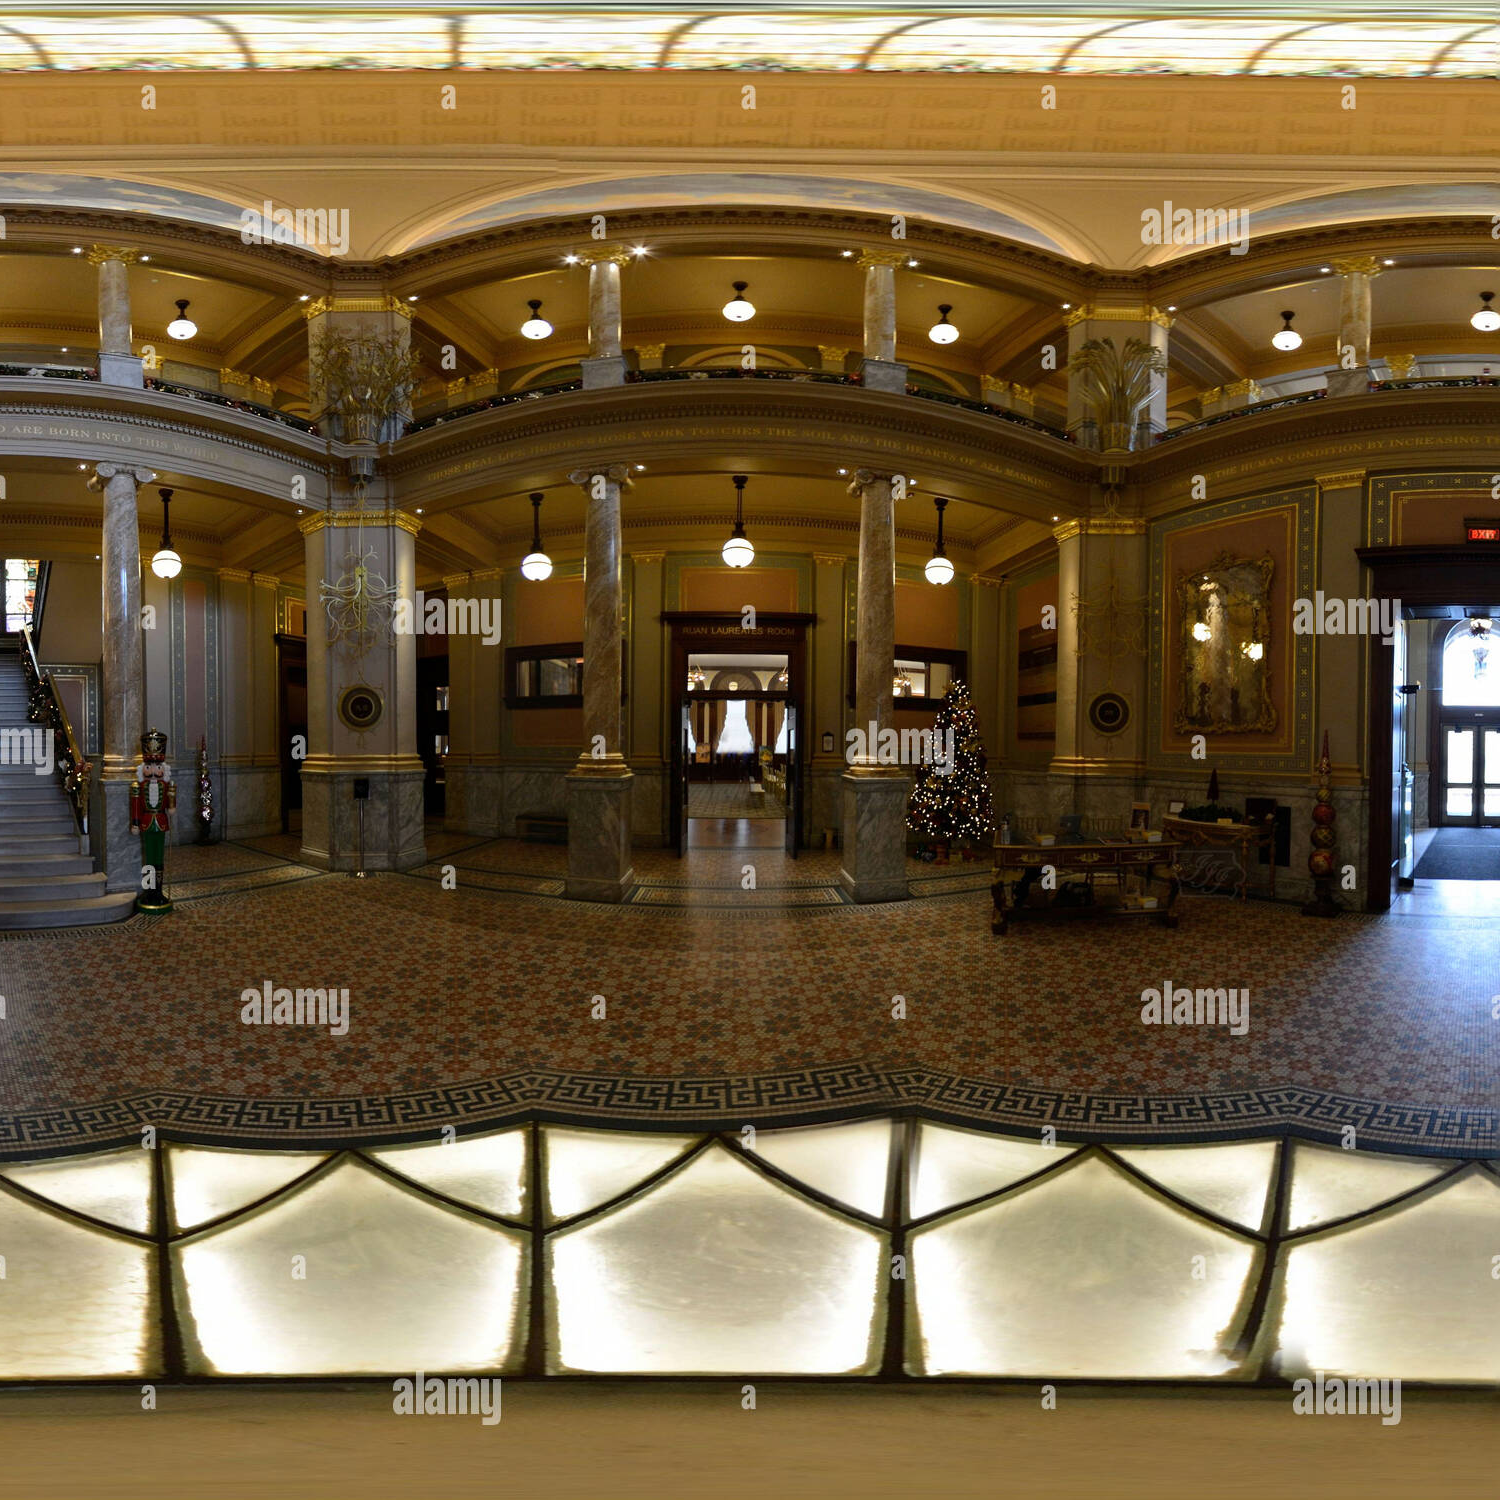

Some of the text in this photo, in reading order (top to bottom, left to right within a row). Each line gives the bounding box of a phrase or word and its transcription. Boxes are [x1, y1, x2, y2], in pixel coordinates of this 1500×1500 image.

[12, 424, 43, 435] ARE
[49, 426, 90, 439] BORN
[95, 430, 132, 443] INTO
[135, 436, 168, 449] THIS
[463, 456, 493, 470] REAL
[641, 428, 685, 439] WORK
[690, 426, 761, 437] TOUCHES
[766, 426, 797, 438] THE
[802, 429, 836, 441] SOIL
[839, 433, 869, 445] AND
[874, 438, 902, 450] THE
[959, 455, 977, 466] OF
[980, 461, 1003, 473] ALL
[1003, 466, 1053, 488] MANKIND
[1241, 456, 1284, 474] HUMAN
[1288, 442, 1363, 463] CONDITION
[1366, 440, 1387, 450] BY
[1389, 436, 1479, 448] INCREASING
[1471, 529, 1497, 540] EXIT
[711, 626, 764, 635] LAUREATES
[767, 627, 796, 636] ROOM
